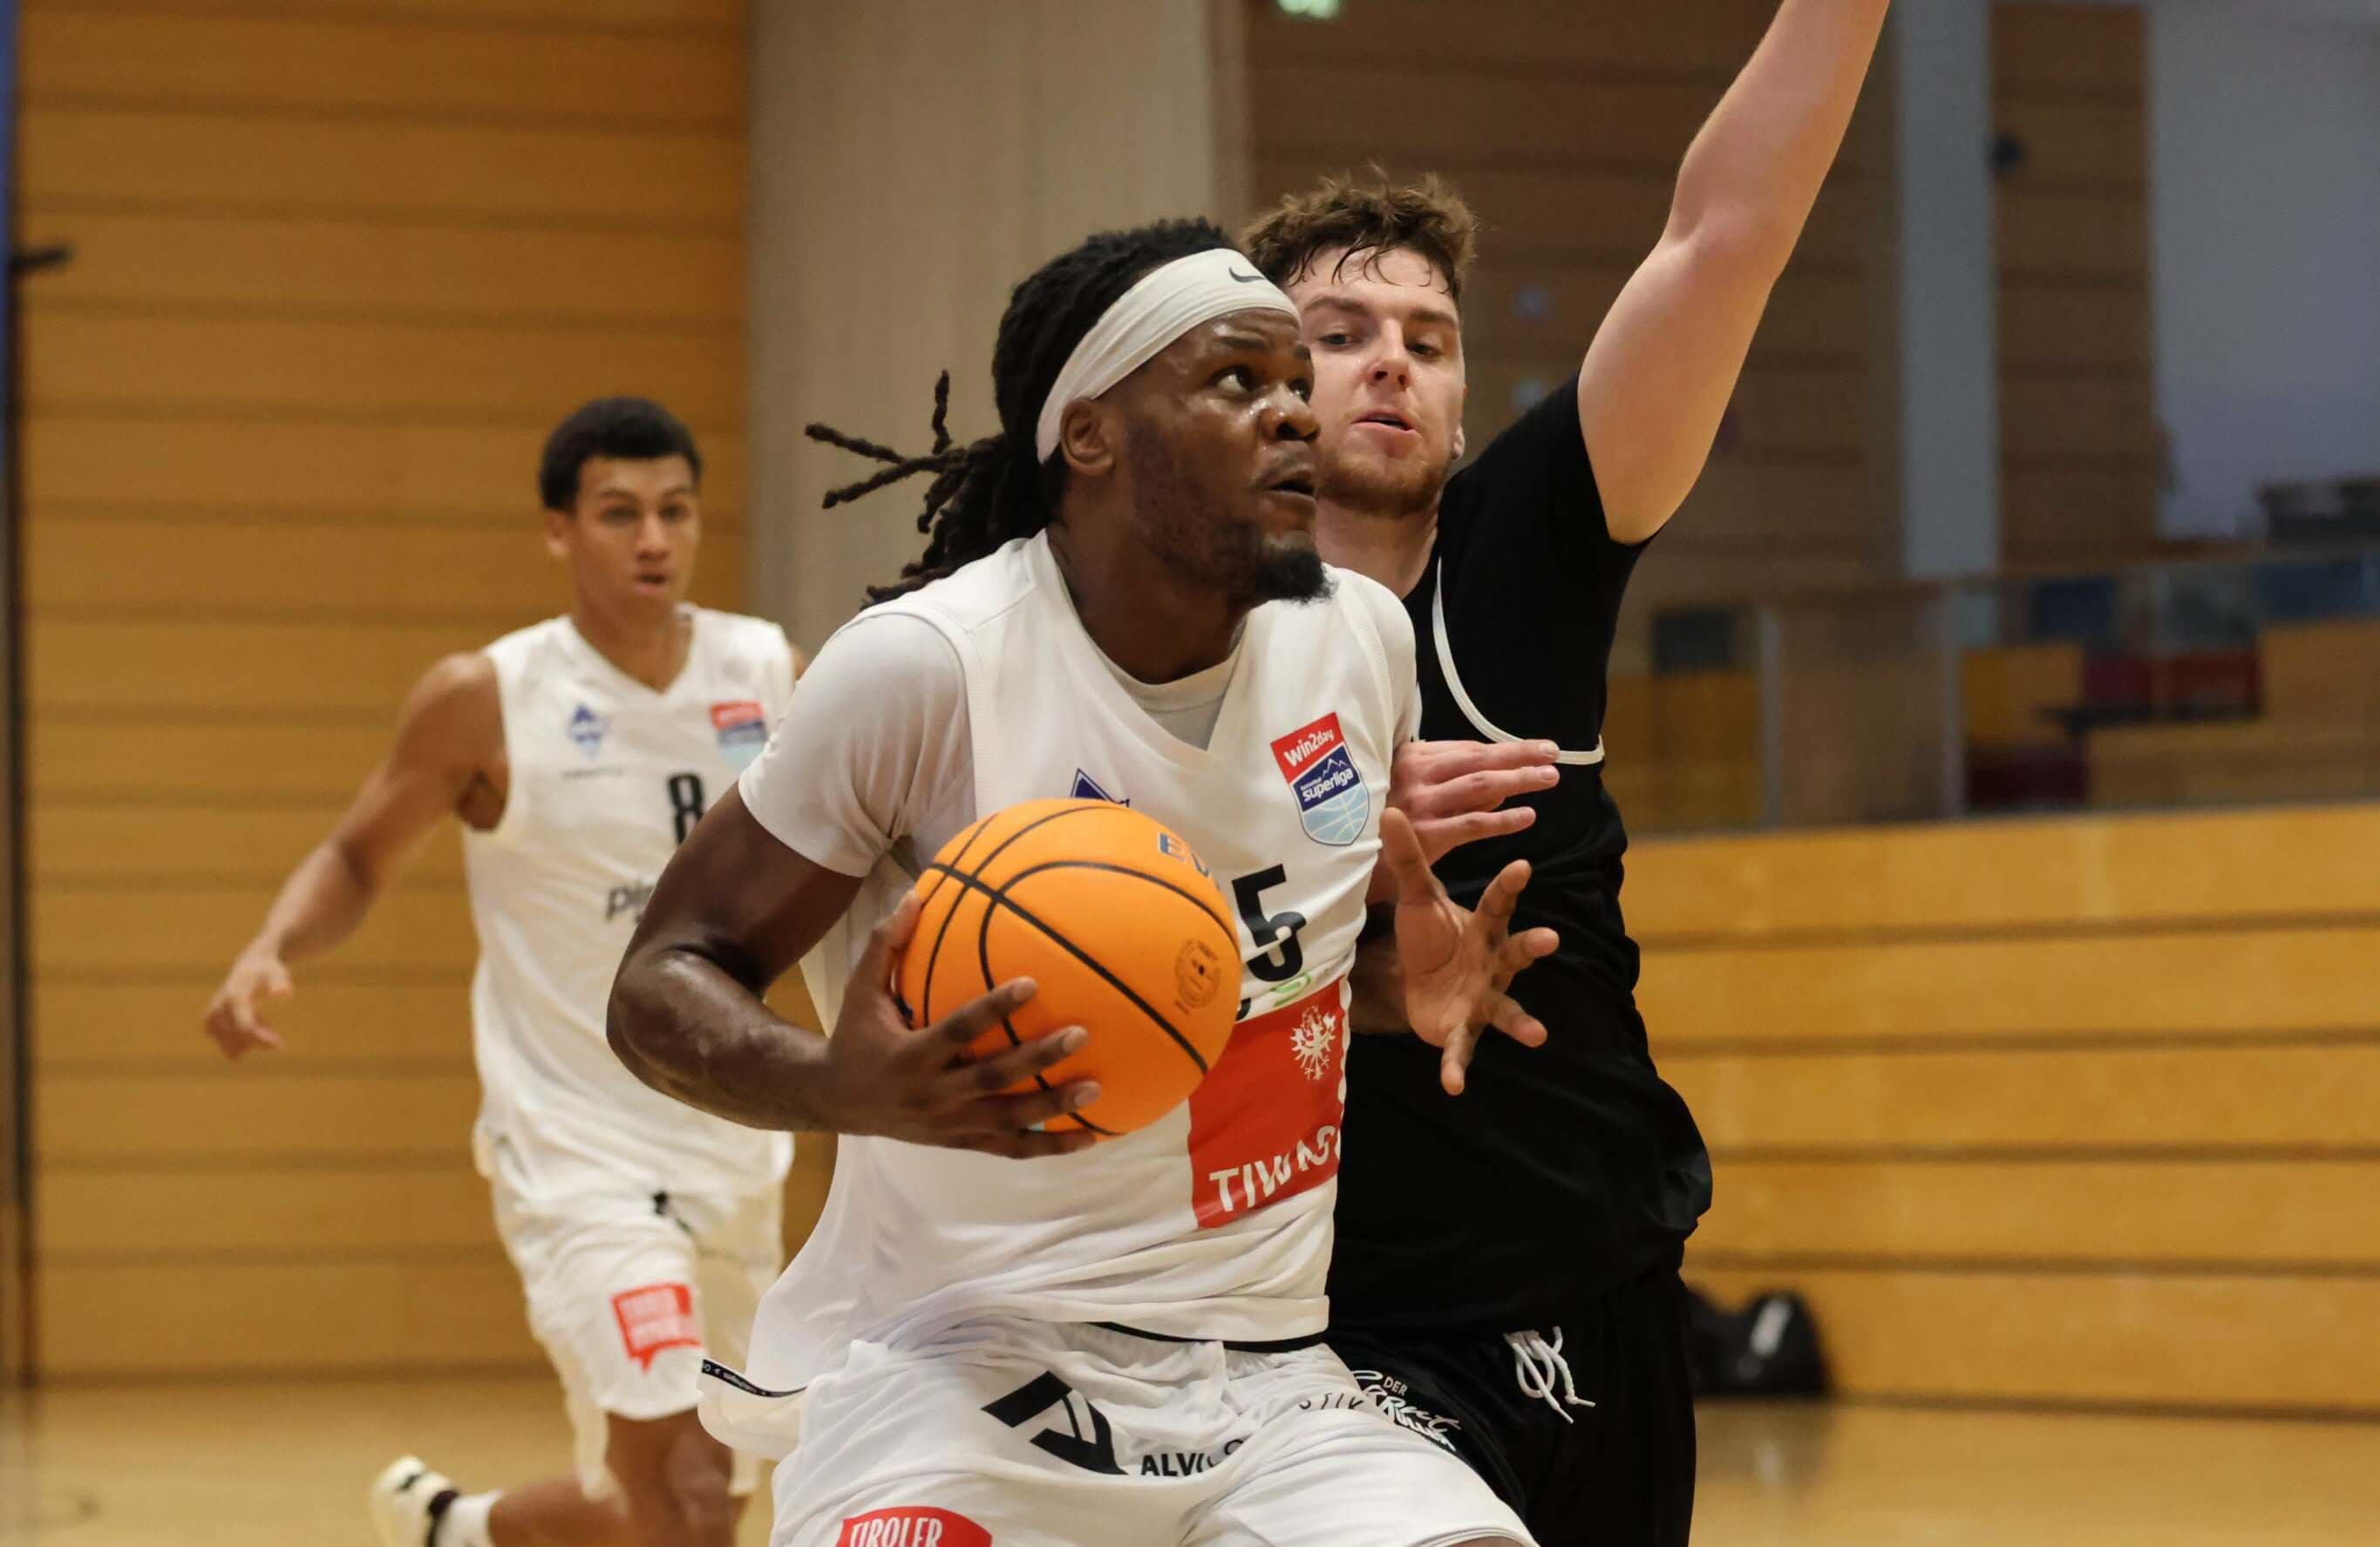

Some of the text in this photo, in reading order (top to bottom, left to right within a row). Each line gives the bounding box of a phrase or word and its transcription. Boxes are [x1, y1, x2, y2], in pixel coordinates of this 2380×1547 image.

[1283, 729, 1335, 767] win2day
[1302, 768, 1353, 802] superliga
[667, 772, 704, 845] 8
[1384, 1376, 1408, 1396] DER
[850, 1516, 943, 1547] TIROLER
